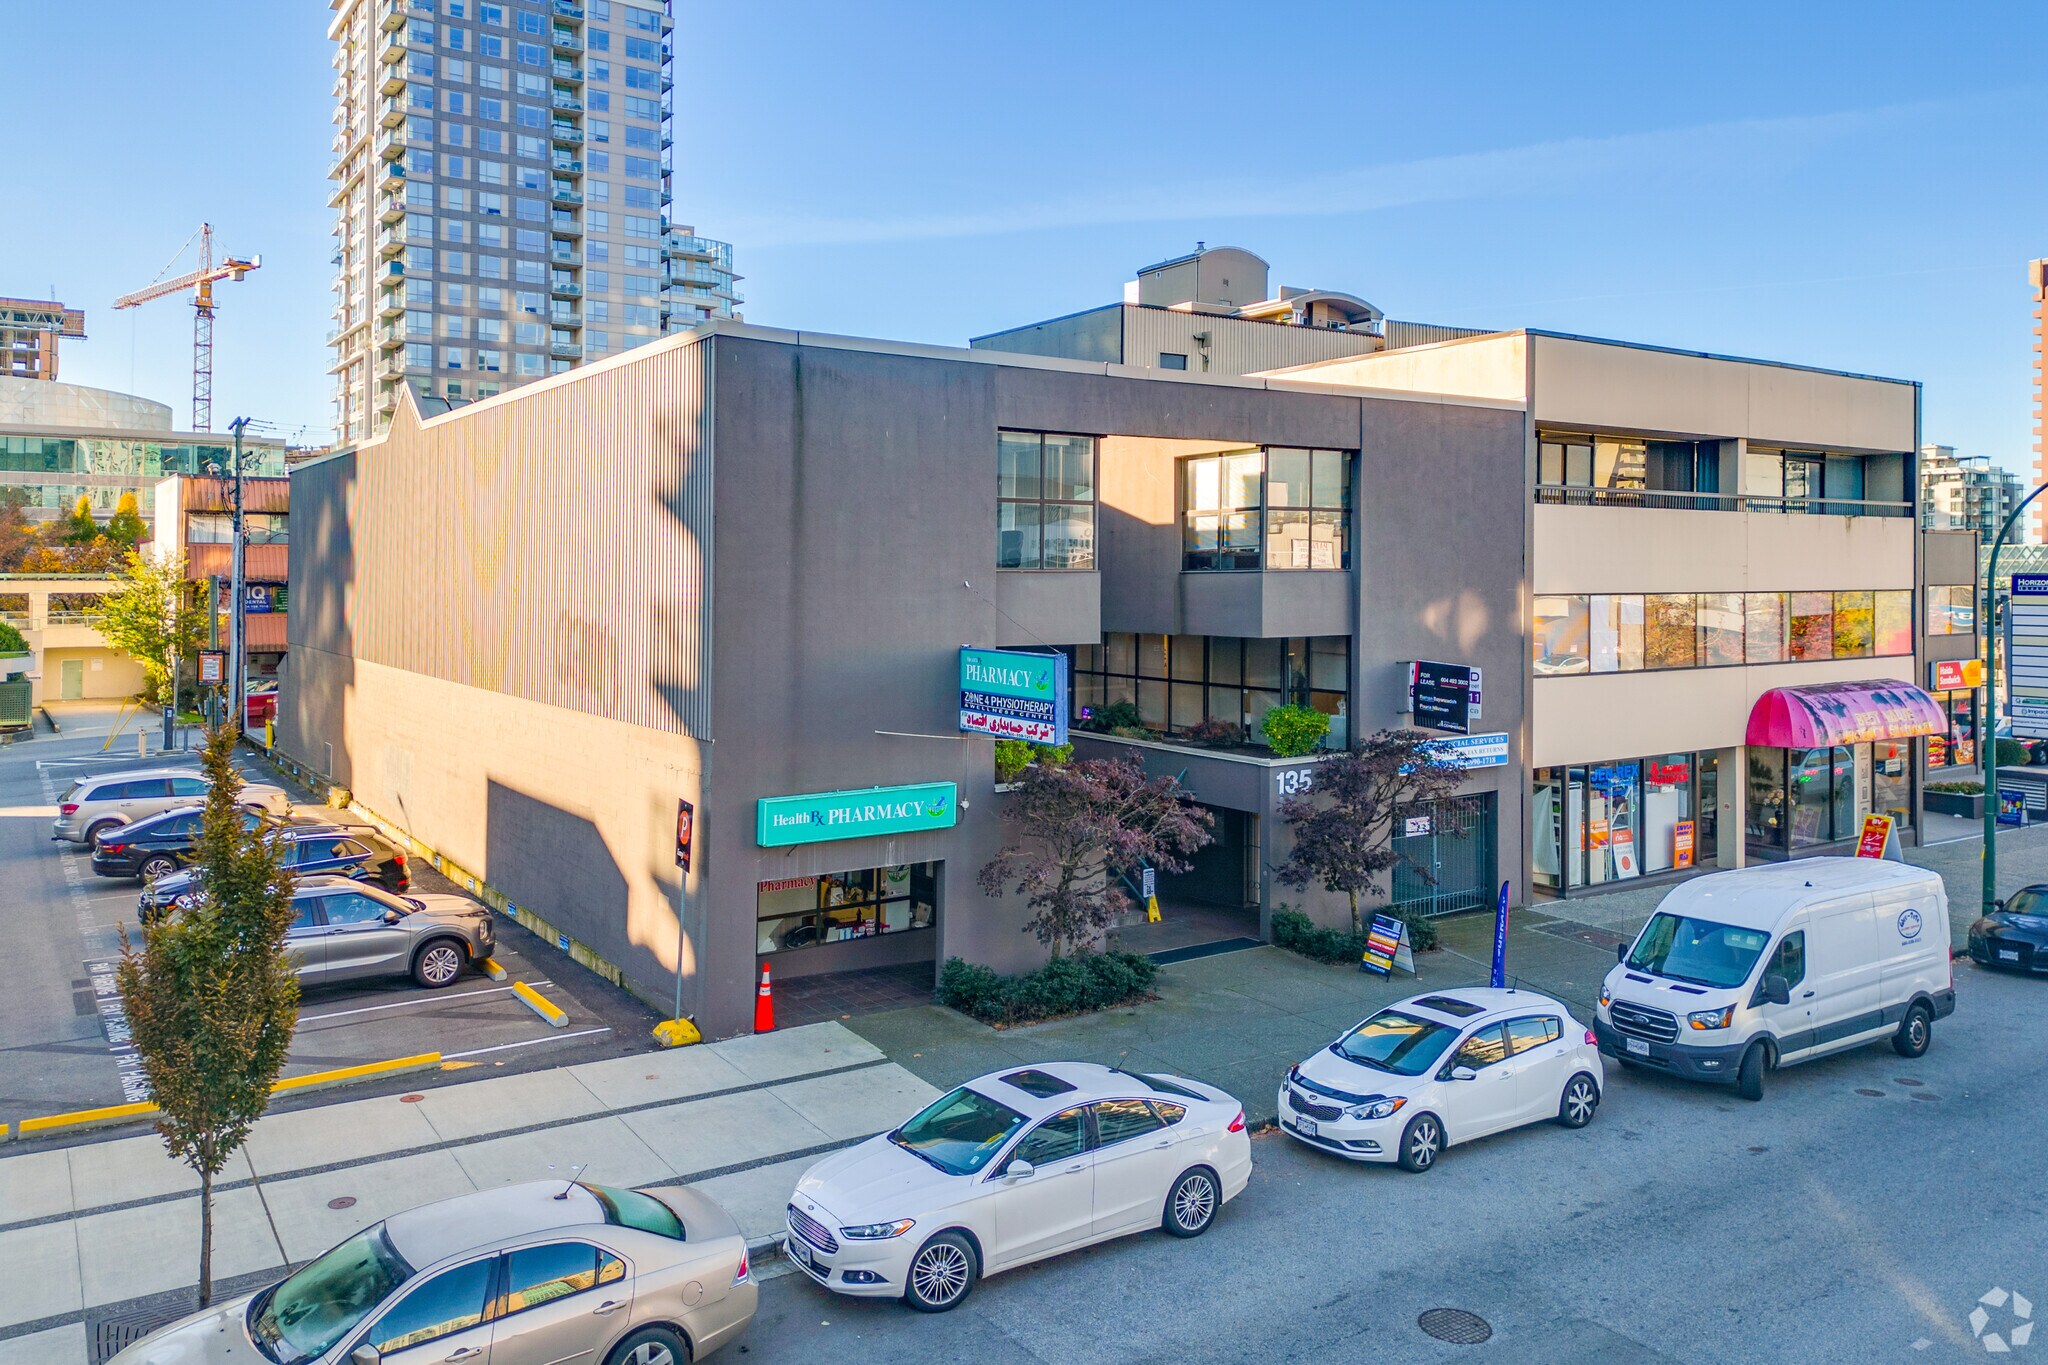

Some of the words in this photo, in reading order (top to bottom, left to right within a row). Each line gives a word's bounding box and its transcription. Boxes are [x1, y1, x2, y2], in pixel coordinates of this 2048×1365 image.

[246, 586, 265, 599] IQ
[966, 664, 1032, 687] PHARMACY
[1470, 672, 1480, 682] D
[1940, 675, 1961, 684] Sandwich
[964, 692, 984, 704] ZONE
[984, 697, 990, 706] 4
[991, 696, 1054, 714] PHYSIOTHERAPY
[1020, 712, 1054, 721] CENTRE
[1470, 736, 1504, 745] SERVICES
[1276, 769, 1312, 794] 135
[828, 801, 924, 824] PHARMACY
[760, 876, 816, 893] Pharmacy
